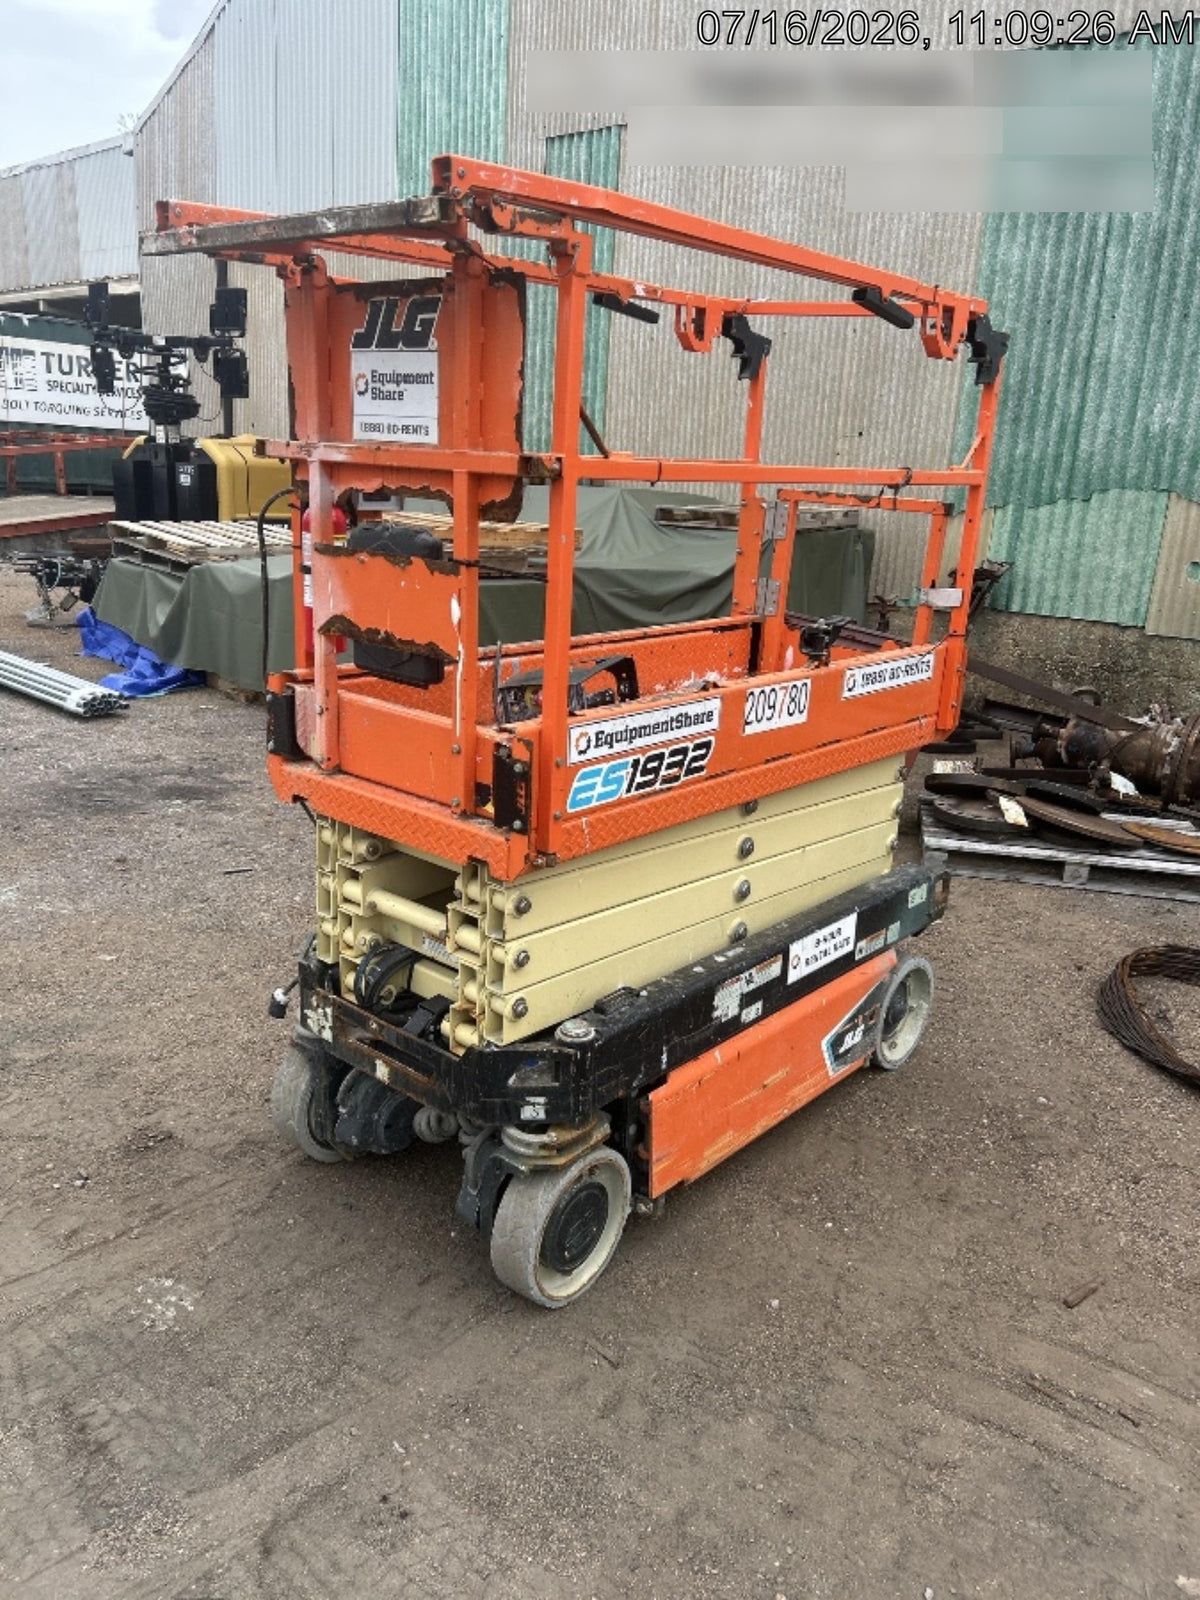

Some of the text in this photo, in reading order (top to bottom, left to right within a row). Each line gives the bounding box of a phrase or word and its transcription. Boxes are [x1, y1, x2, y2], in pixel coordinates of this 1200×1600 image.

[350, 295, 443, 351] JLG
[41, 351, 140, 383] TURER
[371, 369, 435, 387] Equipment
[371, 385, 405, 401] Share
[744, 682, 808, 727] 209780
[593, 708, 714, 750] EquipmentShare
[567, 738, 715, 813] ES1932
